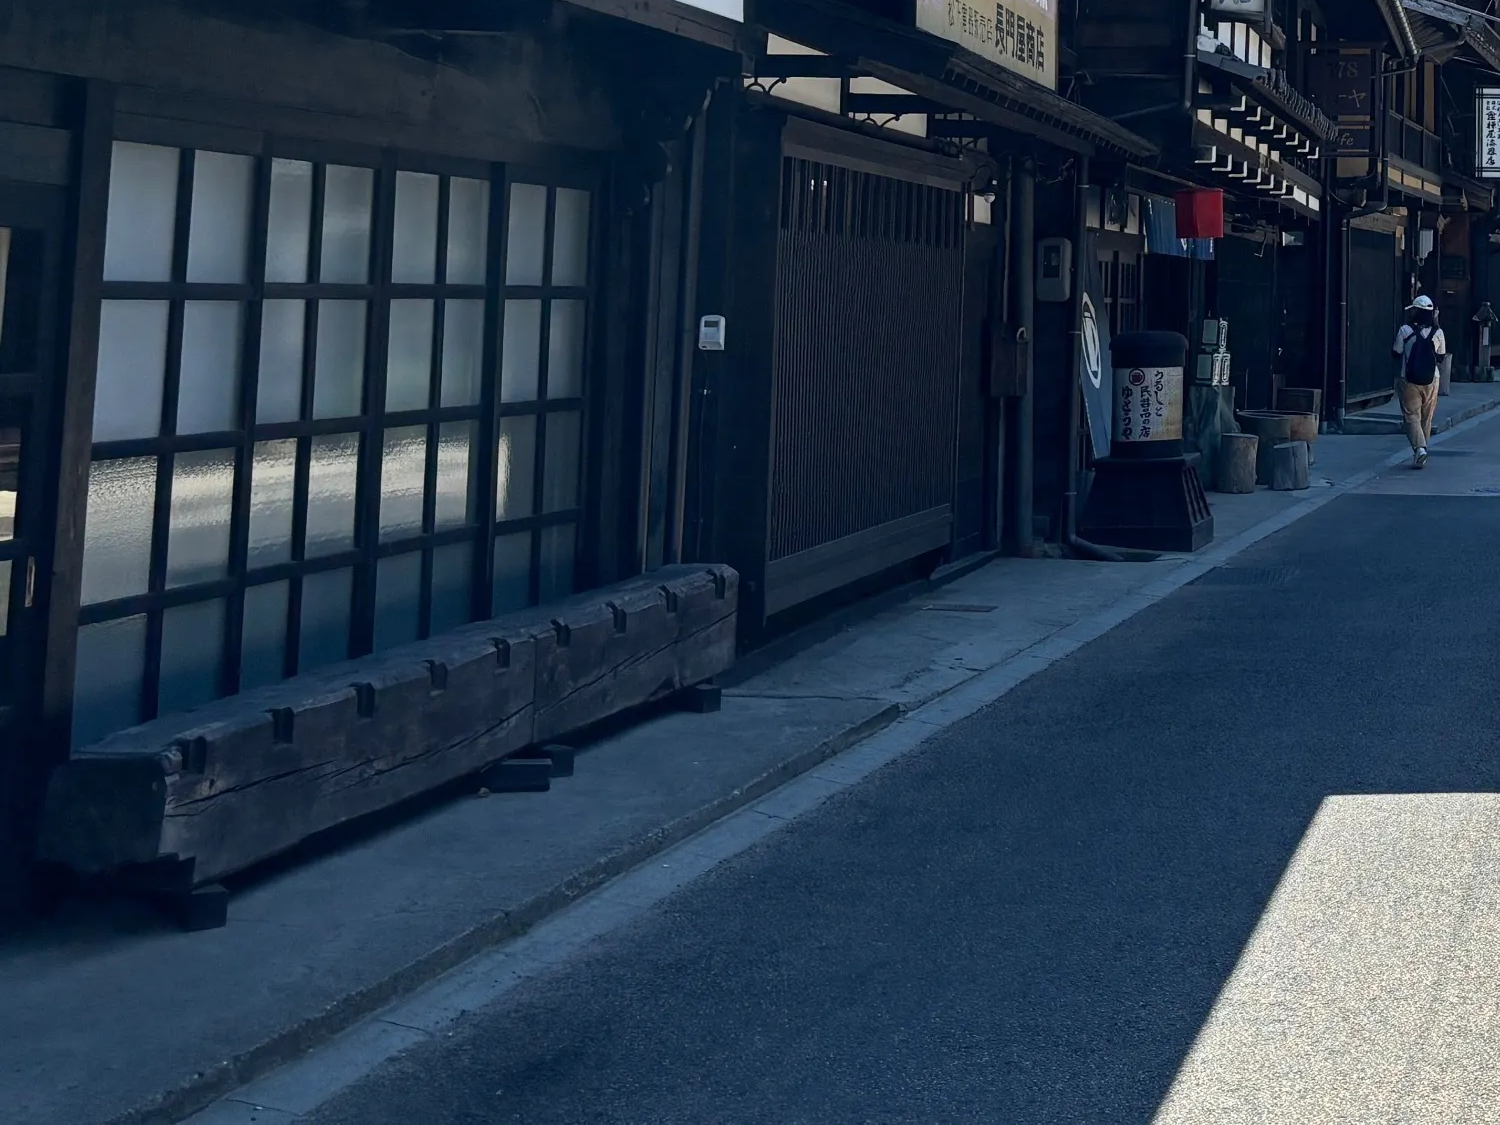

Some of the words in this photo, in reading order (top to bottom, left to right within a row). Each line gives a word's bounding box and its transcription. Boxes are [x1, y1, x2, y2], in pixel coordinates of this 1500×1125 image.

[995, 2, 1045, 72] 長門屋商店
[1340, 132, 1354, 146] fe
[1153, 370, 1164, 417] うるしと
